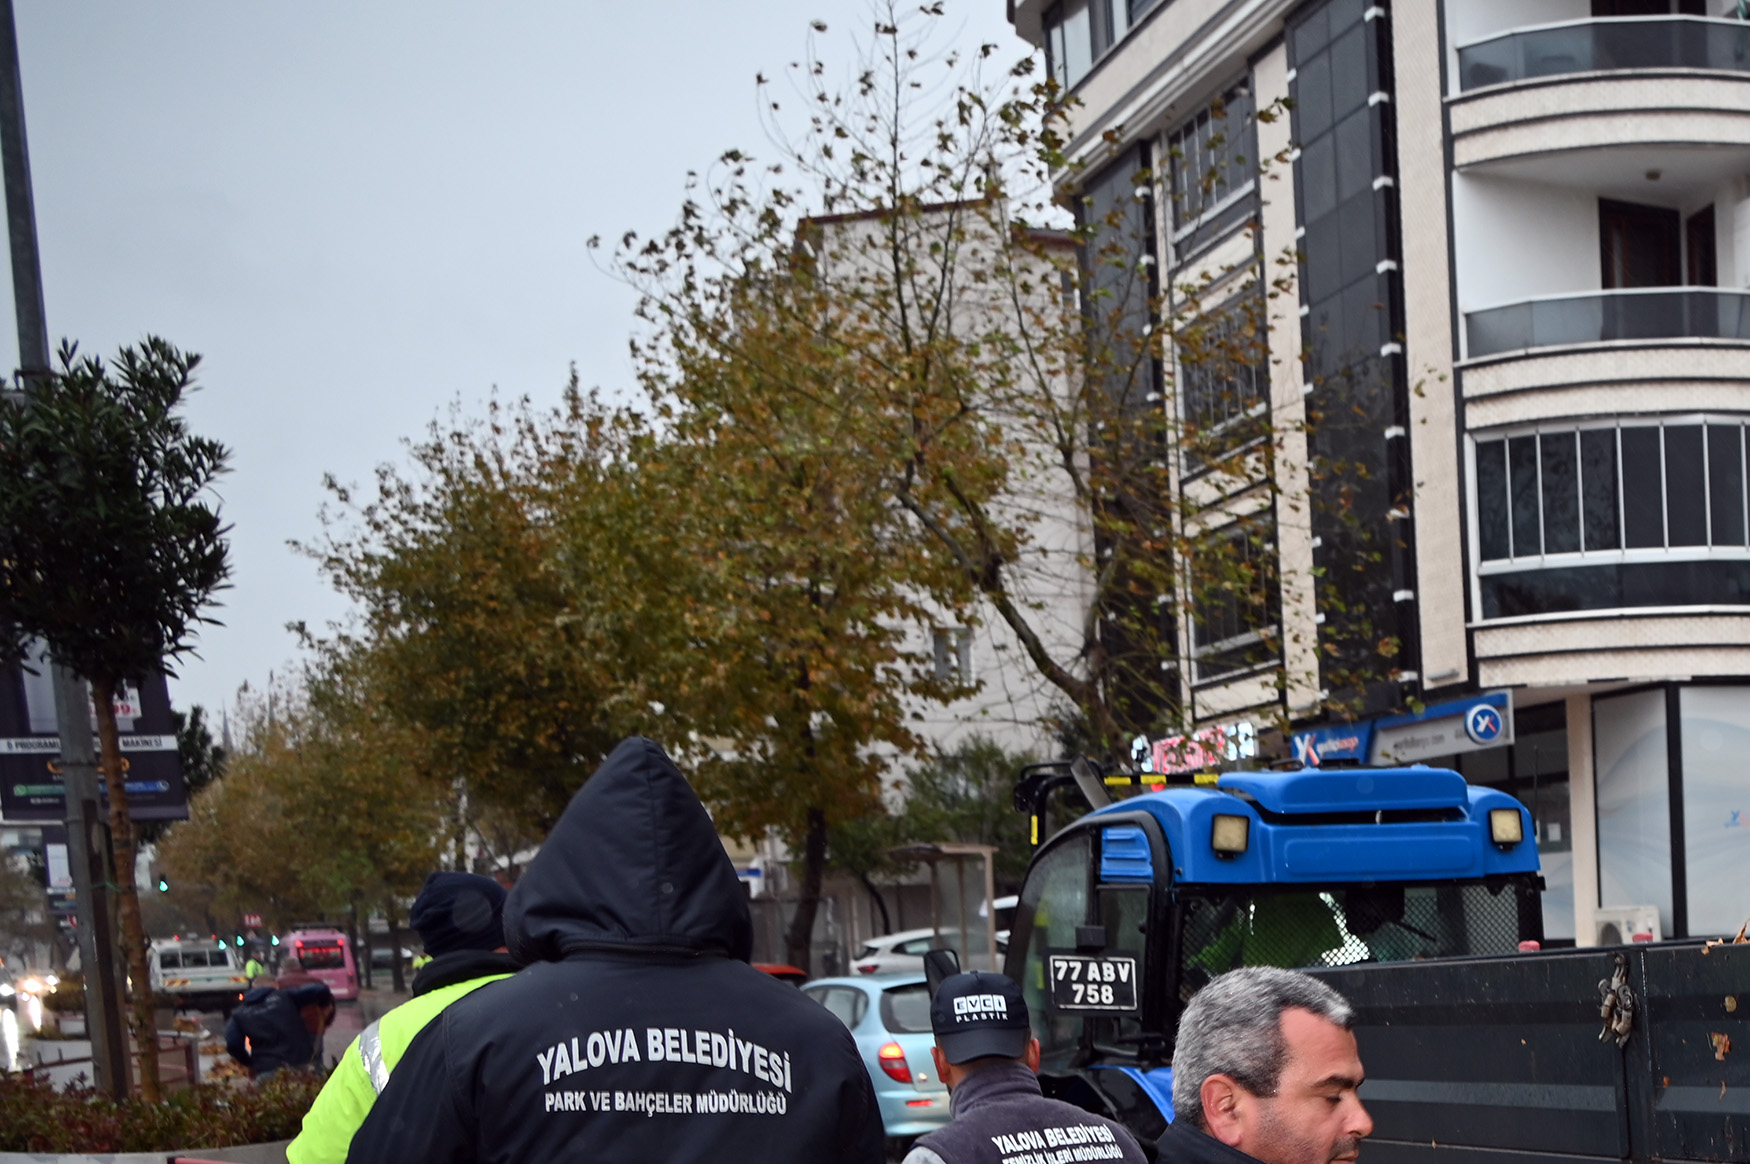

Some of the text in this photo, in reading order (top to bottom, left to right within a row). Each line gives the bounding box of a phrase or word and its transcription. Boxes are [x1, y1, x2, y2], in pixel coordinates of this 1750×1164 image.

[1054, 960, 1130, 983] 77 ABV
[1072, 983, 1114, 1005] 758
[956, 1011, 1008, 1023] PLASTİK
[537, 1028, 793, 1093] YALOVA BELEDİYESİ
[545, 1088, 787, 1117] PARK VE BAHÇELER MÜDÜRLÜĞÜ
[991, 1122, 1116, 1155] YALOVA BELEDİYESİ
[1072, 1143, 1124, 1162] MÜDÜRLÜĞÜ
